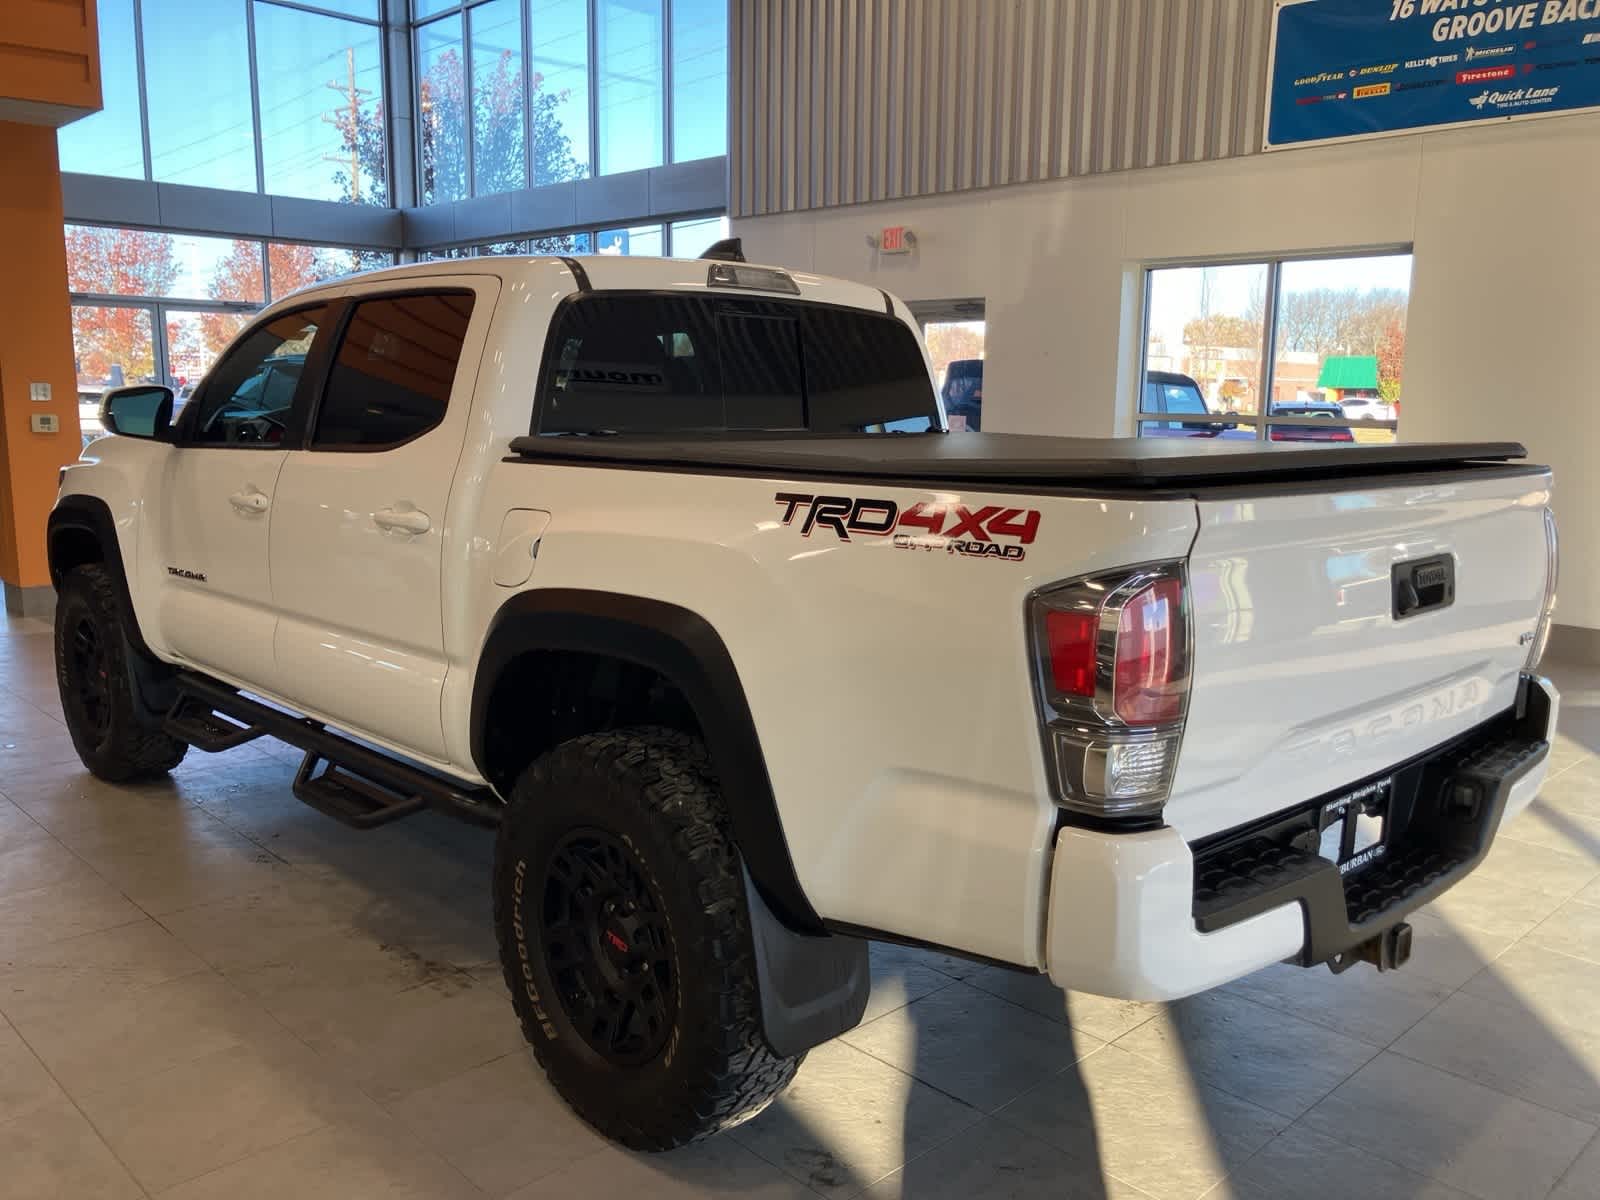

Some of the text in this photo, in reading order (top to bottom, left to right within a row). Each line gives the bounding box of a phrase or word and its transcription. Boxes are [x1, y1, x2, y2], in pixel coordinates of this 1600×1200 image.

[1390, 0, 1414, 20] 16
[1432, 3, 1538, 42] GROOVE
[1474, 46, 1515, 57] MICHELIN
[1359, 63, 1399, 75] DUNLOP
[1404, 58, 1426, 69] KELLY
[1294, 72, 1345, 86] GOODYEAR
[1461, 69, 1511, 83] Firestone
[1488, 86, 1558, 104] Quick Lane
[775, 492, 899, 543] TRD
[946, 540, 1026, 561] ROAD
[168, 567, 207, 582] TACOMA
[1340, 850, 1374, 875] BURBAN
